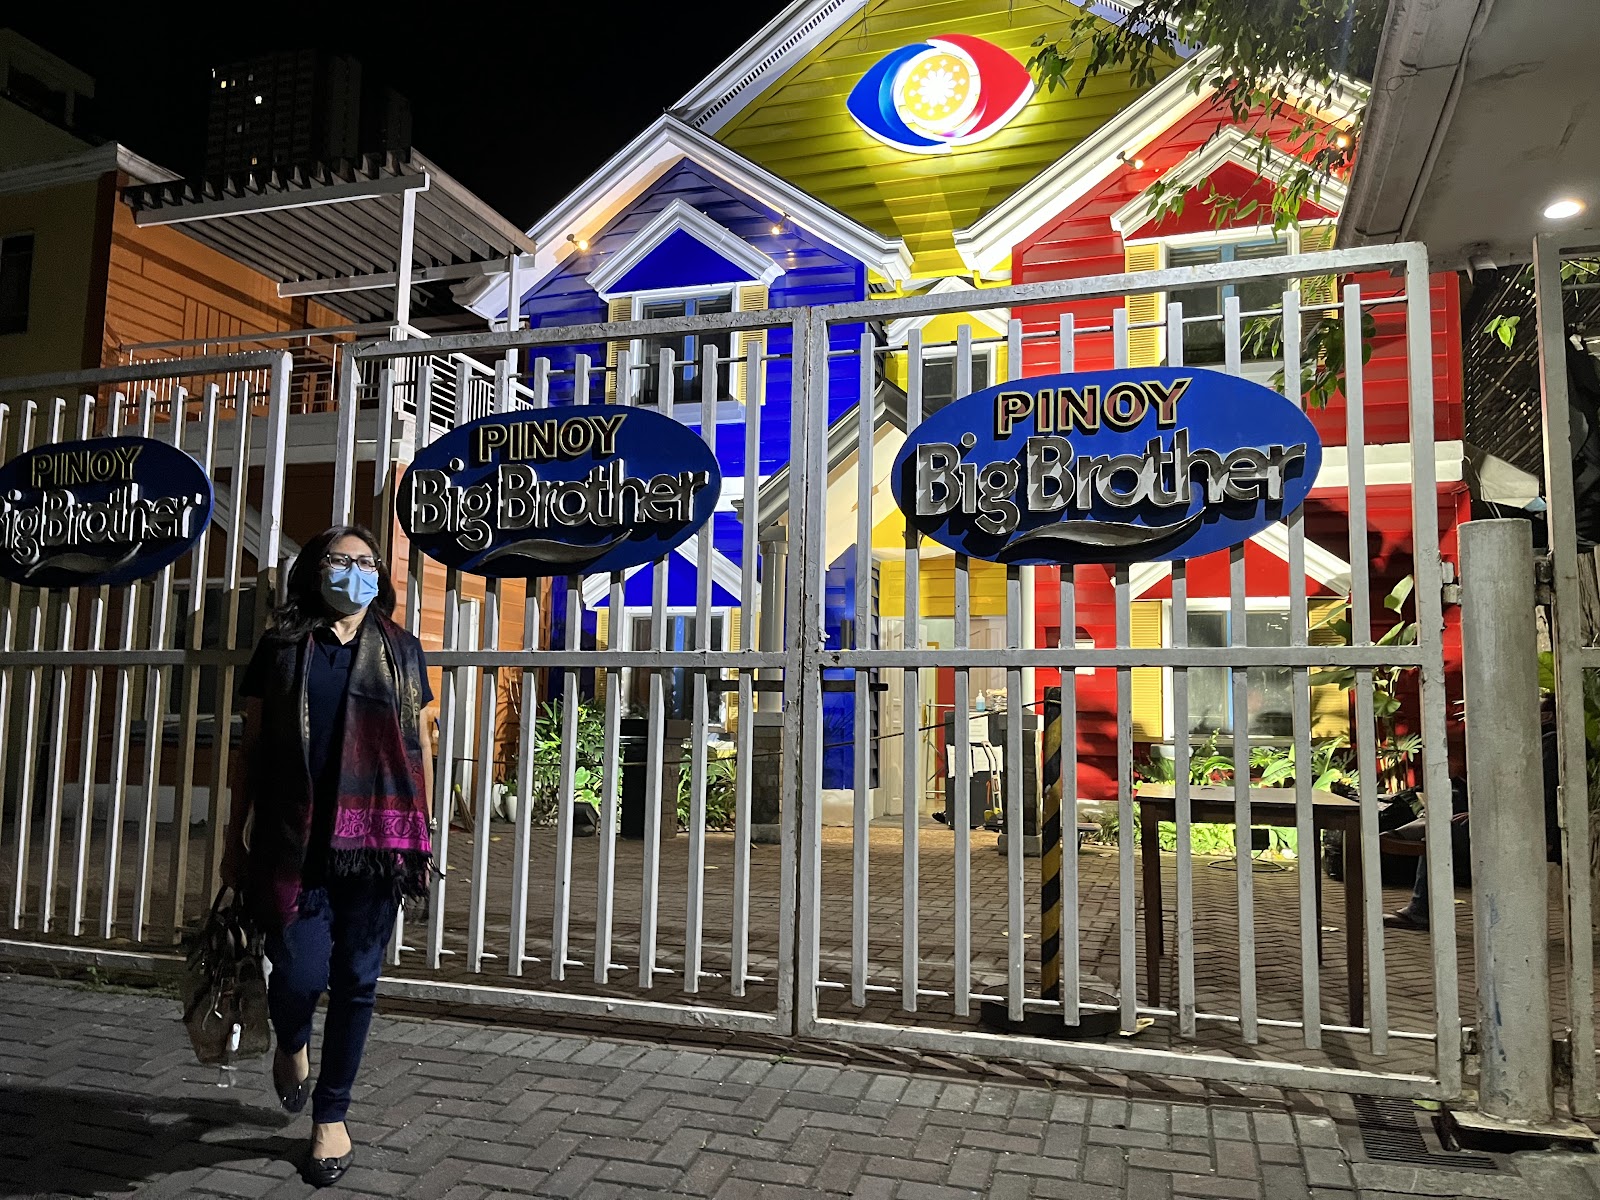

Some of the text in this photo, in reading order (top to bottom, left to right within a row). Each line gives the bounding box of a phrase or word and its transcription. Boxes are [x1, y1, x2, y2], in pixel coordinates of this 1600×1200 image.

[478, 413, 628, 463] PINOY
[996, 377, 1193, 434] PINOY
[31, 446, 143, 488] PINOY
[915, 427, 1307, 536] Big Brother
[0, 482, 203, 566] ig Brother
[410, 457, 710, 551] Big Brother
